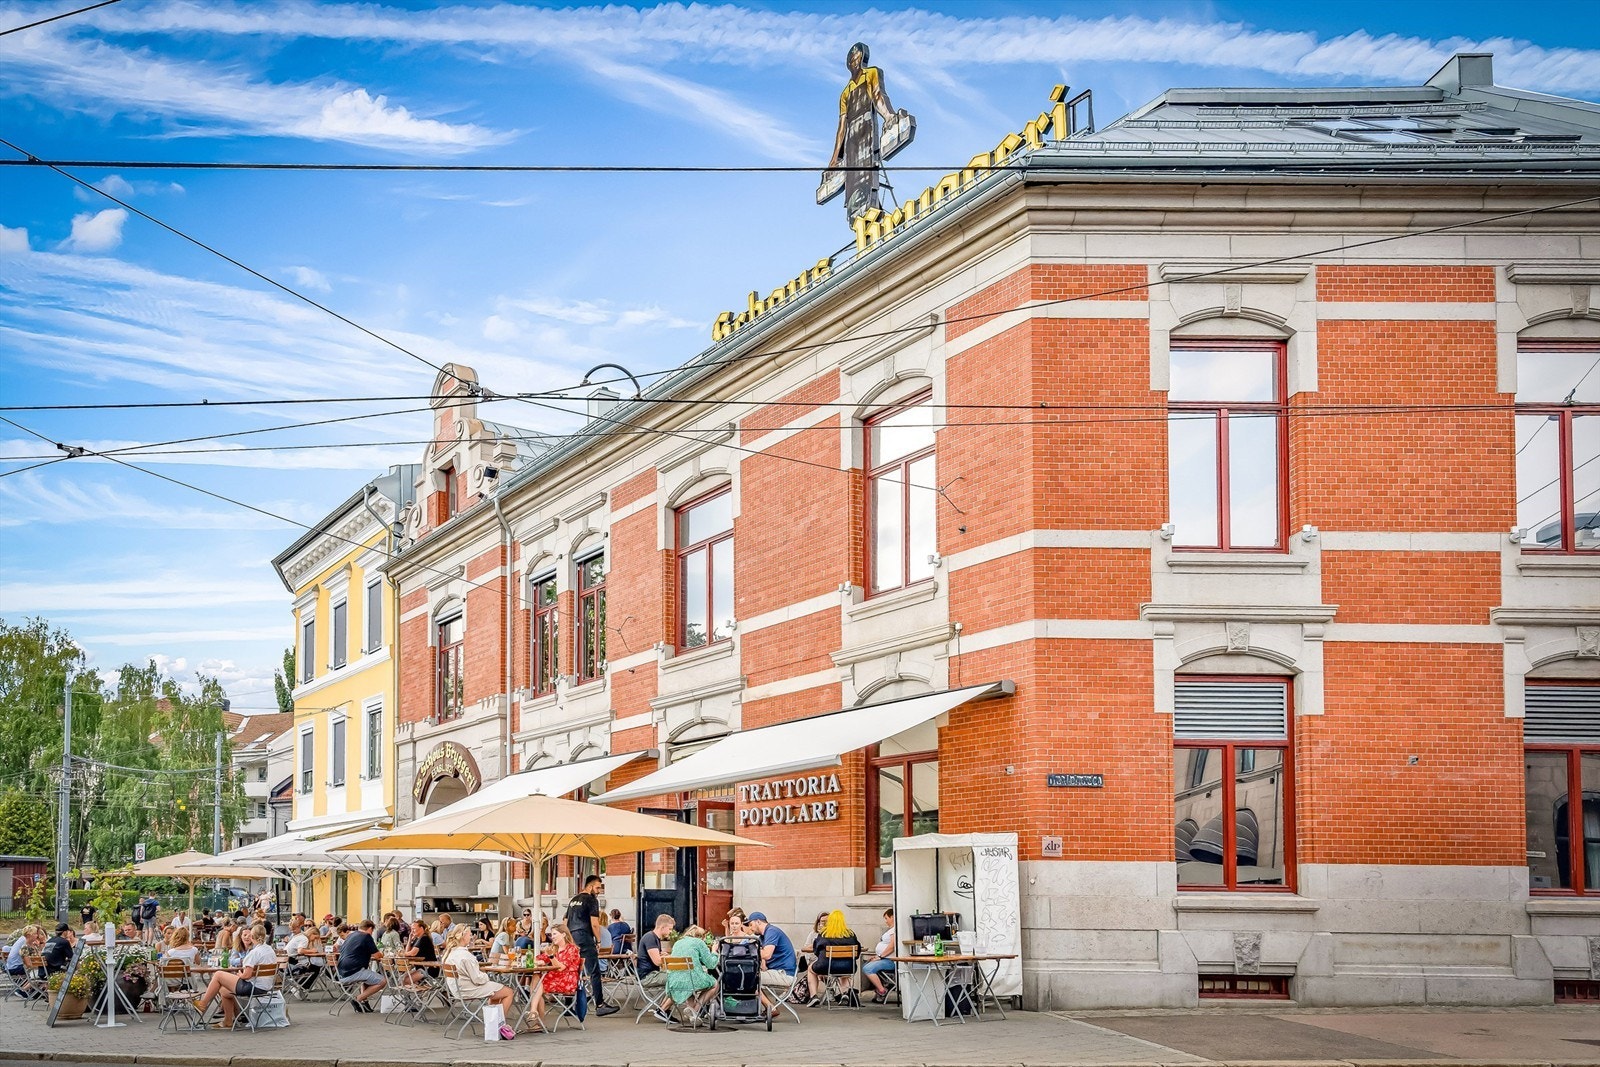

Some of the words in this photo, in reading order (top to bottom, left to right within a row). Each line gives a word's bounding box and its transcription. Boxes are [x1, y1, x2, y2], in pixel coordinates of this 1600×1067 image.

[445, 743, 475, 788] Bryggeri
[739, 774, 841, 802] TRATTORIA
[739, 799, 840, 826] POPOLARE
